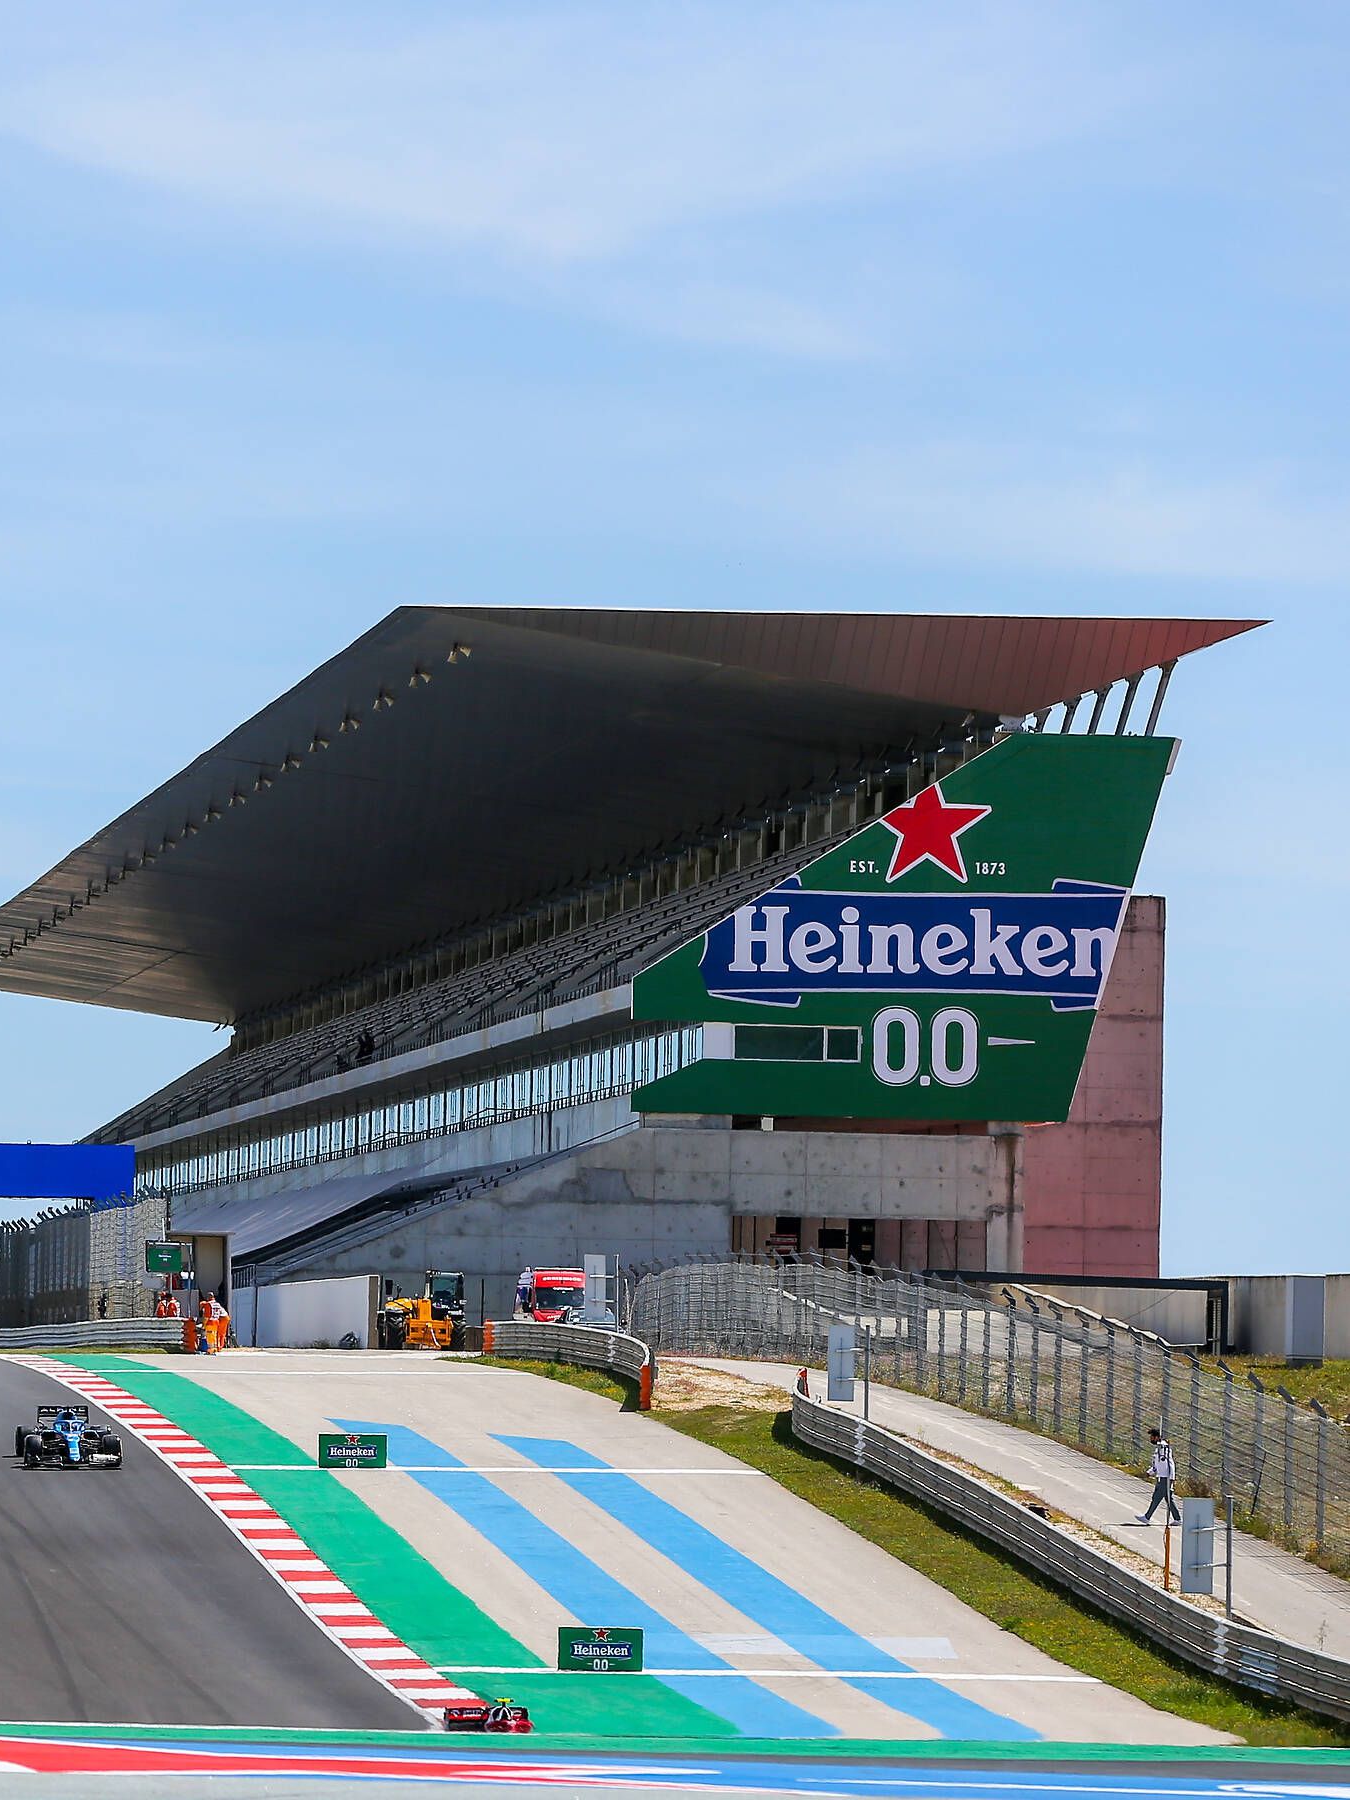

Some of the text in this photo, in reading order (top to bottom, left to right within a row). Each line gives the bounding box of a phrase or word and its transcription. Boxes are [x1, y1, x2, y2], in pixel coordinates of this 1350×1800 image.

[849, 860, 1006, 876] EST. 1873
[727, 904, 1117, 978] Heineken
[871, 1005, 979, 1087] 0.0
[330, 1447, 375, 1456] Heineken
[573, 1644, 629, 1656] Heineken
